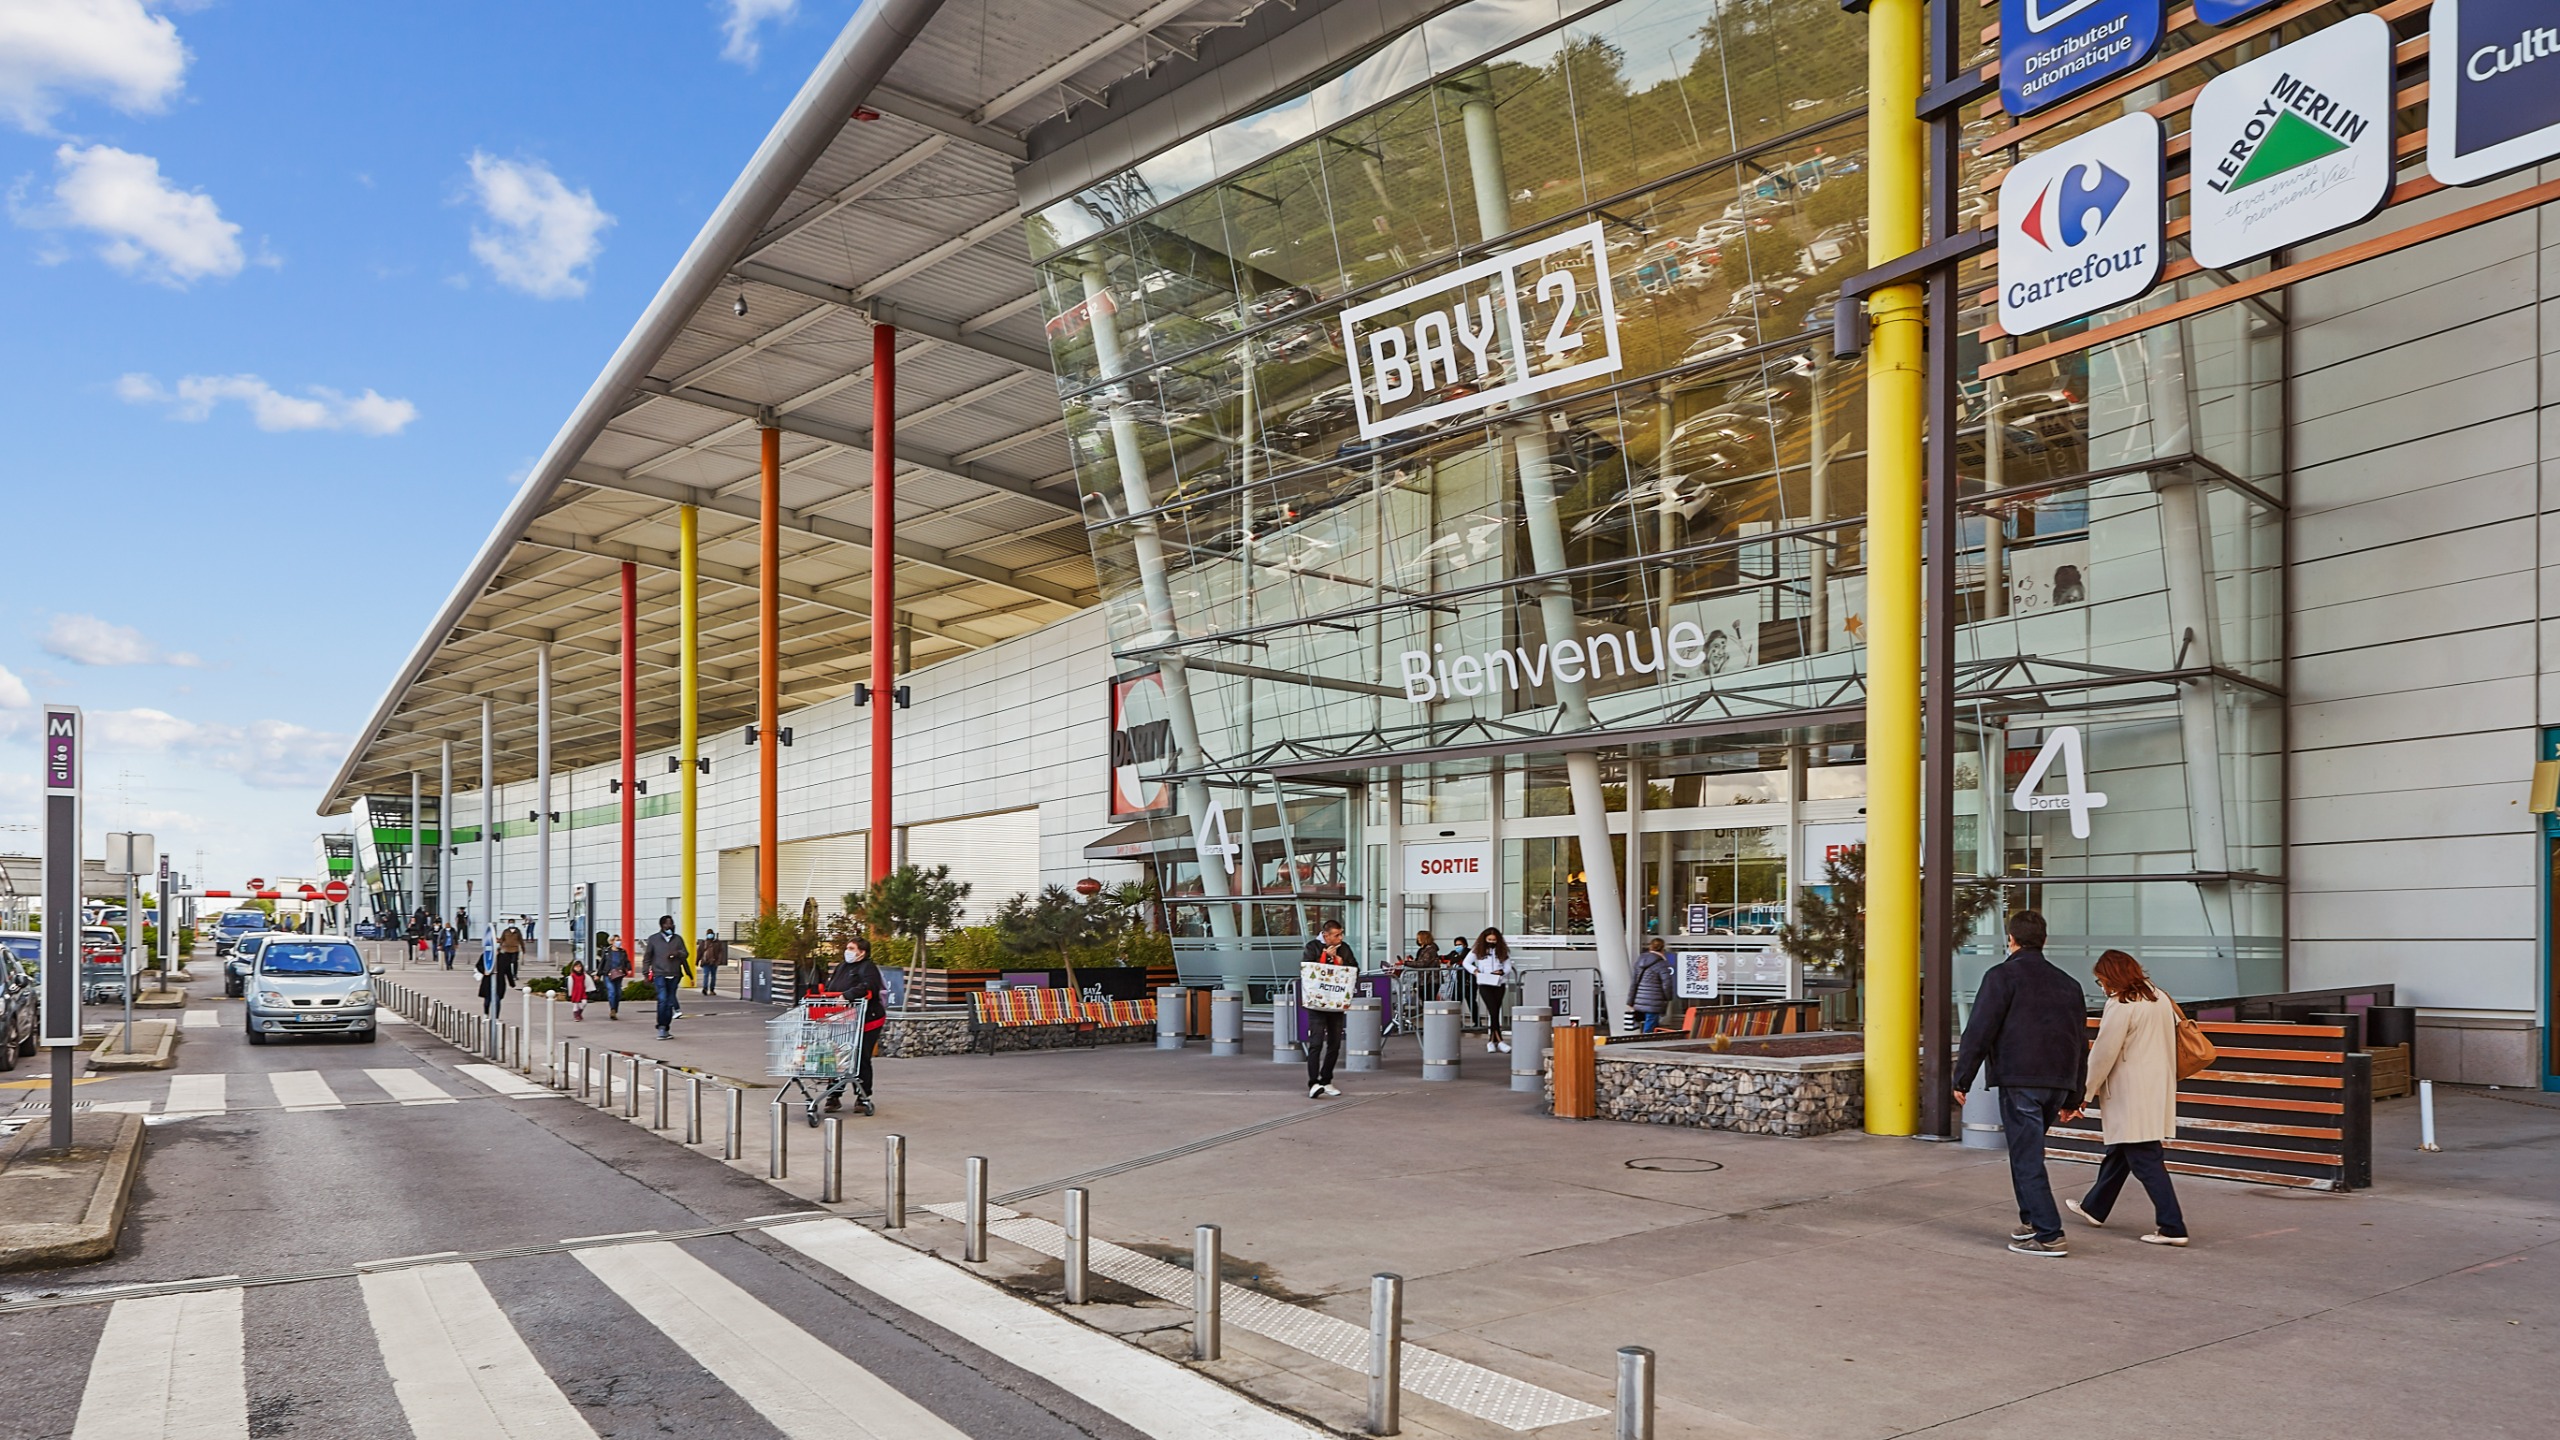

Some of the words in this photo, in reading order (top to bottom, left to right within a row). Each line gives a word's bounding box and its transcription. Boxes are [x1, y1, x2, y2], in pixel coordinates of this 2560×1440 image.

[2022, 36, 2131, 97] automatique
[2025, 15, 2128, 74] Distributeur
[2270, 72, 2369, 143] MERLIN
[2206, 98, 2277, 193] LEROY
[2008, 243, 2147, 309] Carrefour
[1369, 295, 1495, 405] BAY
[1536, 270, 1583, 356] 2
[1400, 621, 1707, 704] Bienvenue
[49, 718, 73, 737] M
[1113, 719, 1170, 767] DARTY
[2013, 726, 2108, 839] 4
[2030, 797, 2070, 809] Porte
[1196, 800, 1240, 875] 4
[1421, 857, 1479, 875] SORTIE
[1319, 983, 1346, 993] ACTION
[1552, 984, 1568, 996] BAY
[1562, 1001, 1567, 1012] 2
